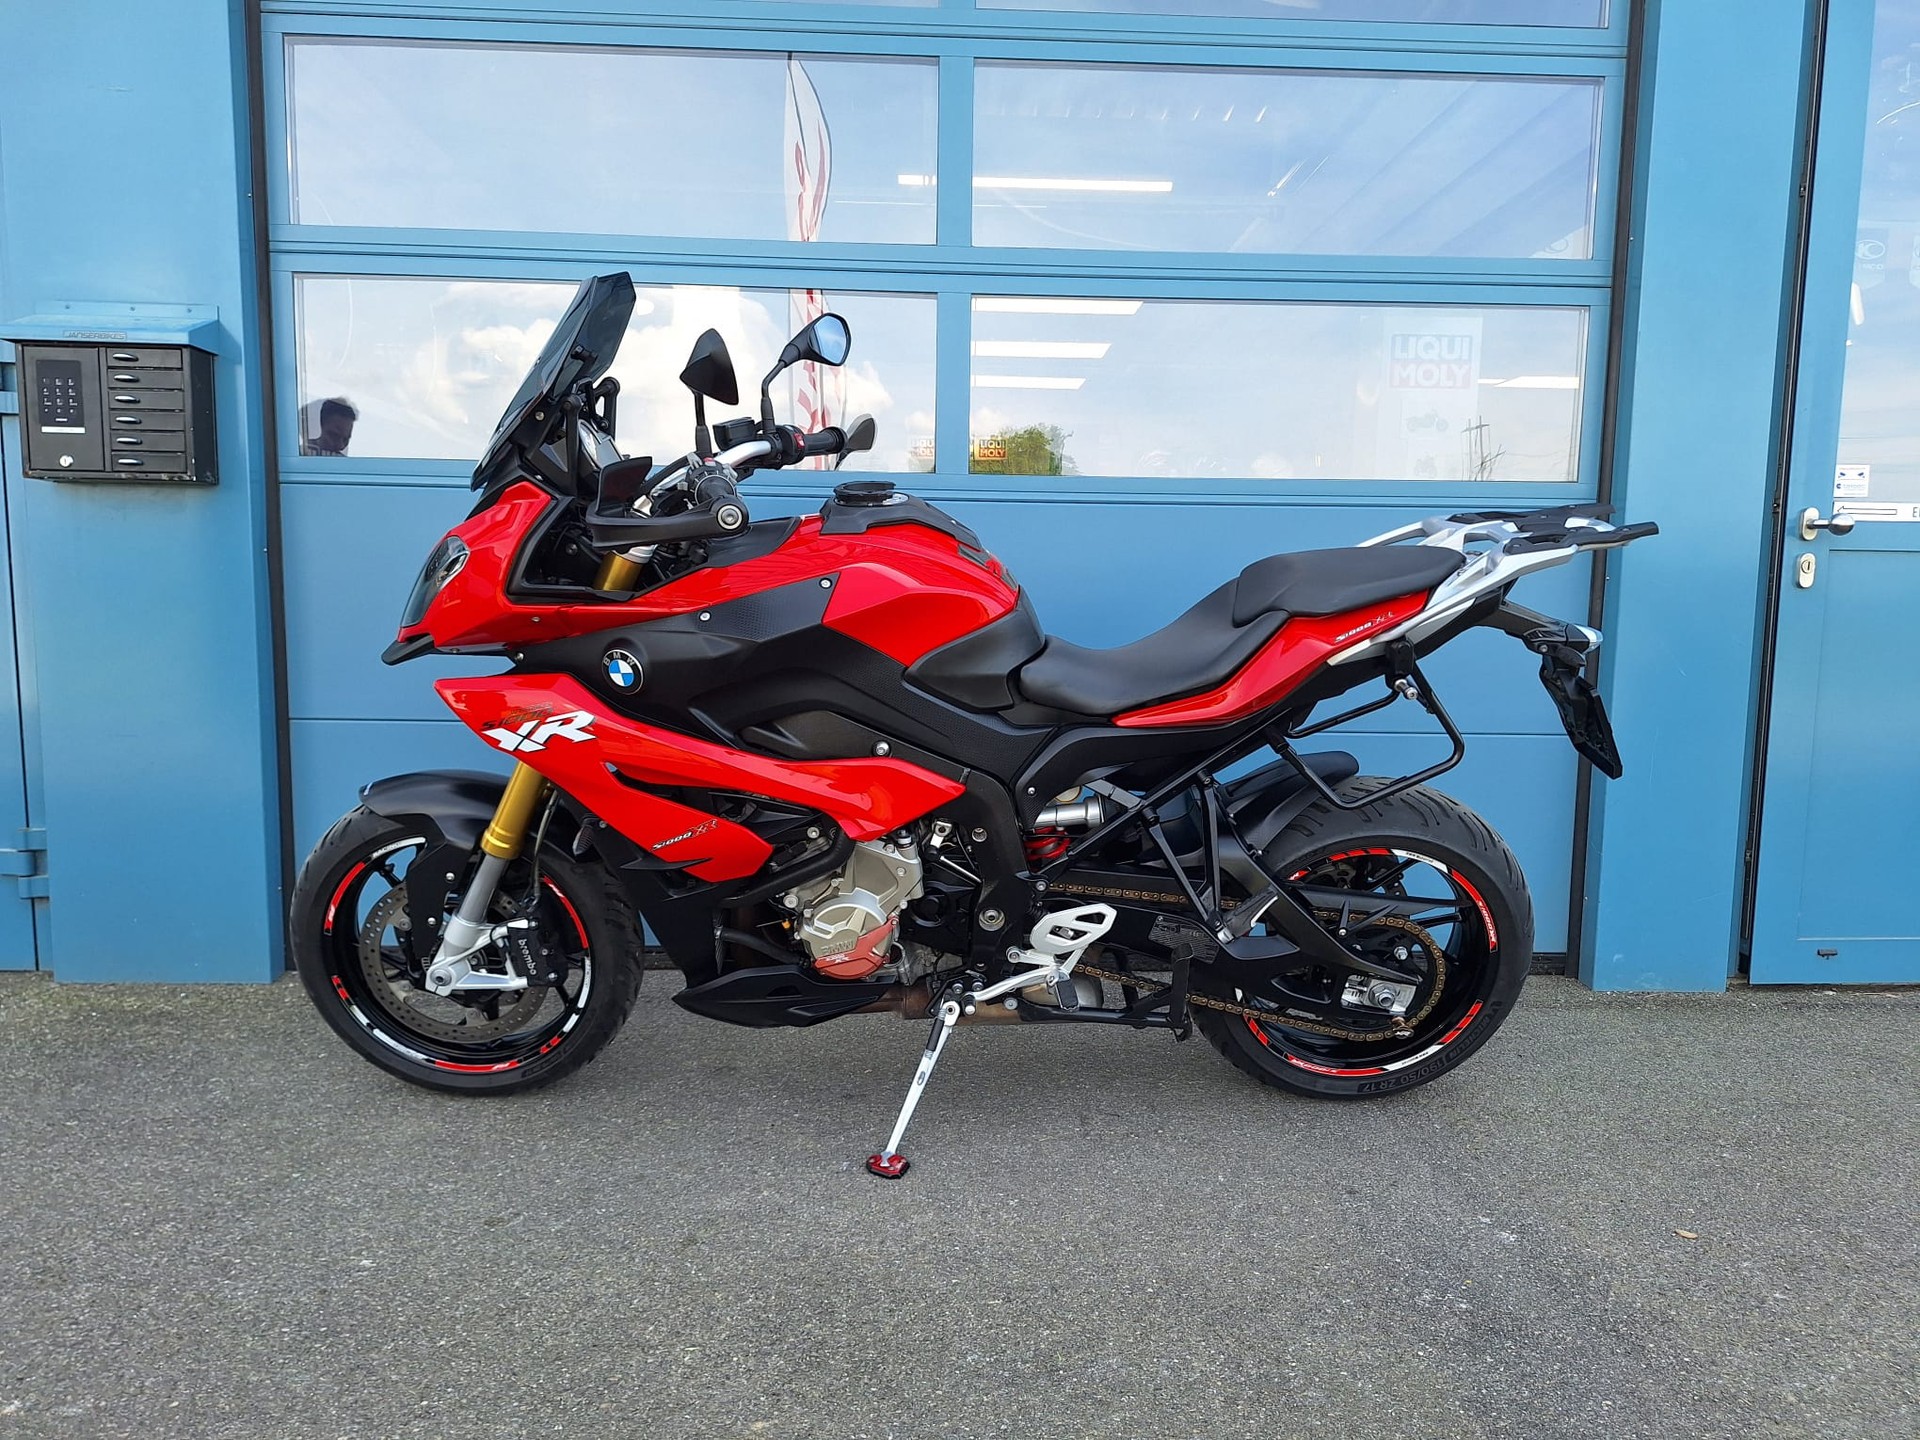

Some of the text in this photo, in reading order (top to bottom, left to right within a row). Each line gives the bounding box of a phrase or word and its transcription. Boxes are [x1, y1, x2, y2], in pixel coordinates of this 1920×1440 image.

[1394, 336, 1470, 360] LIQUI
[1391, 362, 1470, 387] MOLY
[980, 440, 1005, 449] LIQUI
[980, 449, 1005, 457] MOLY
[481, 710, 597, 753] XR
[518, 939, 537, 975] brembo
